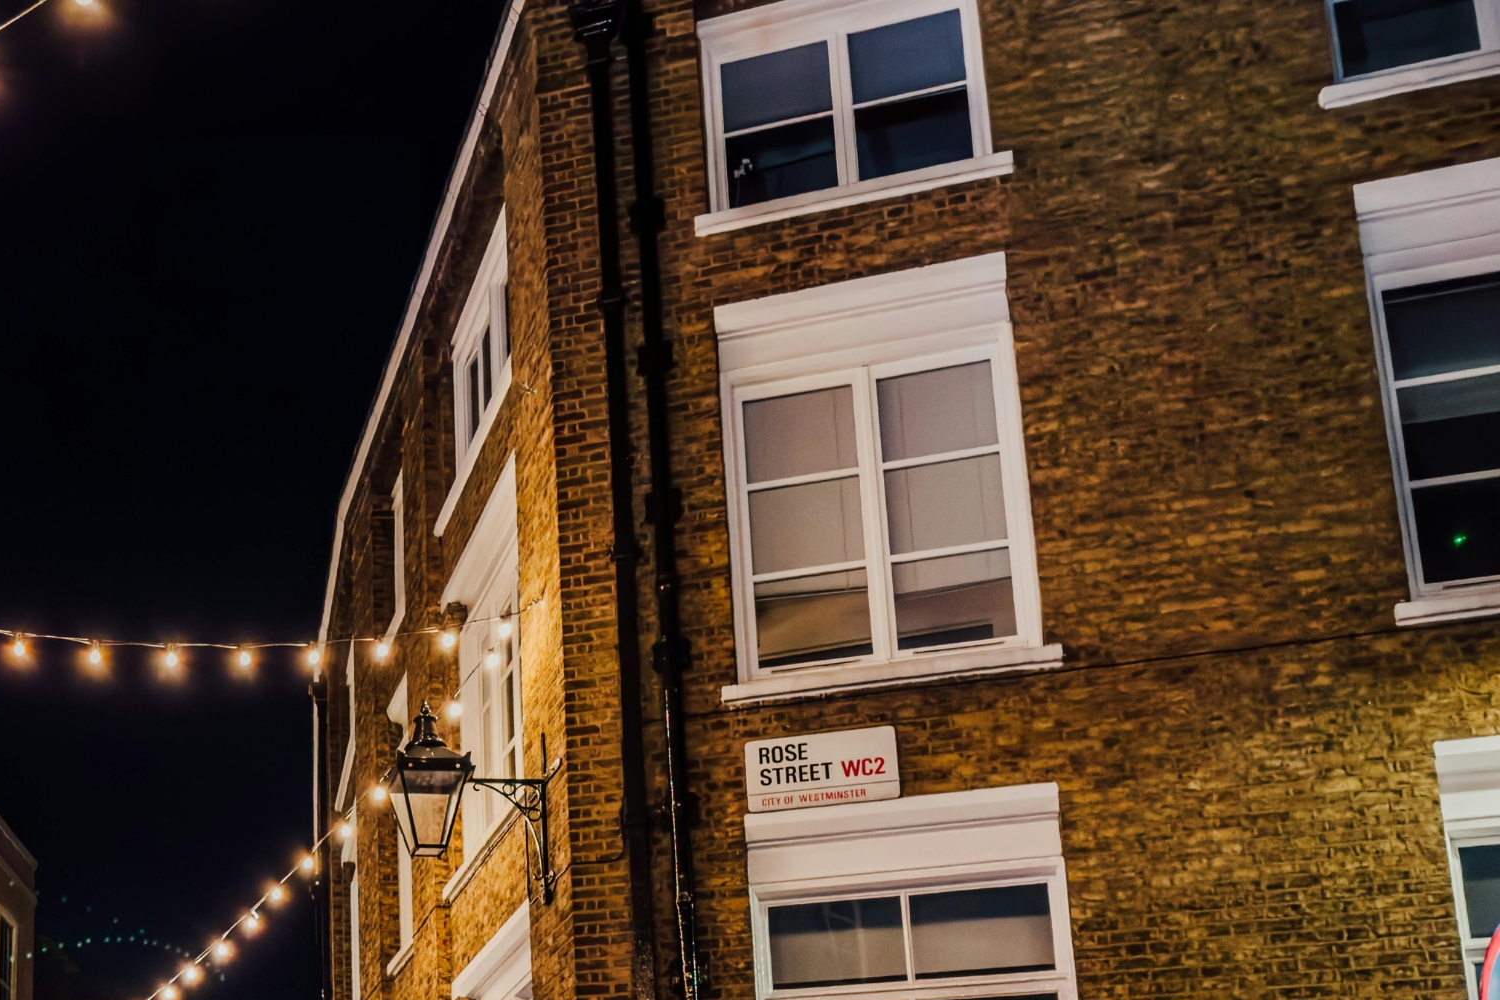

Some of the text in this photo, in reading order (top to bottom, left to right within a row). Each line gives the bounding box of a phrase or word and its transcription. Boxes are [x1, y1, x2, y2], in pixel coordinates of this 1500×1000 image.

[758, 742, 808, 765] ROSE
[760, 757, 886, 786] STREET WC2
[761, 788, 866, 807] CITY OF WESTMINSTER
